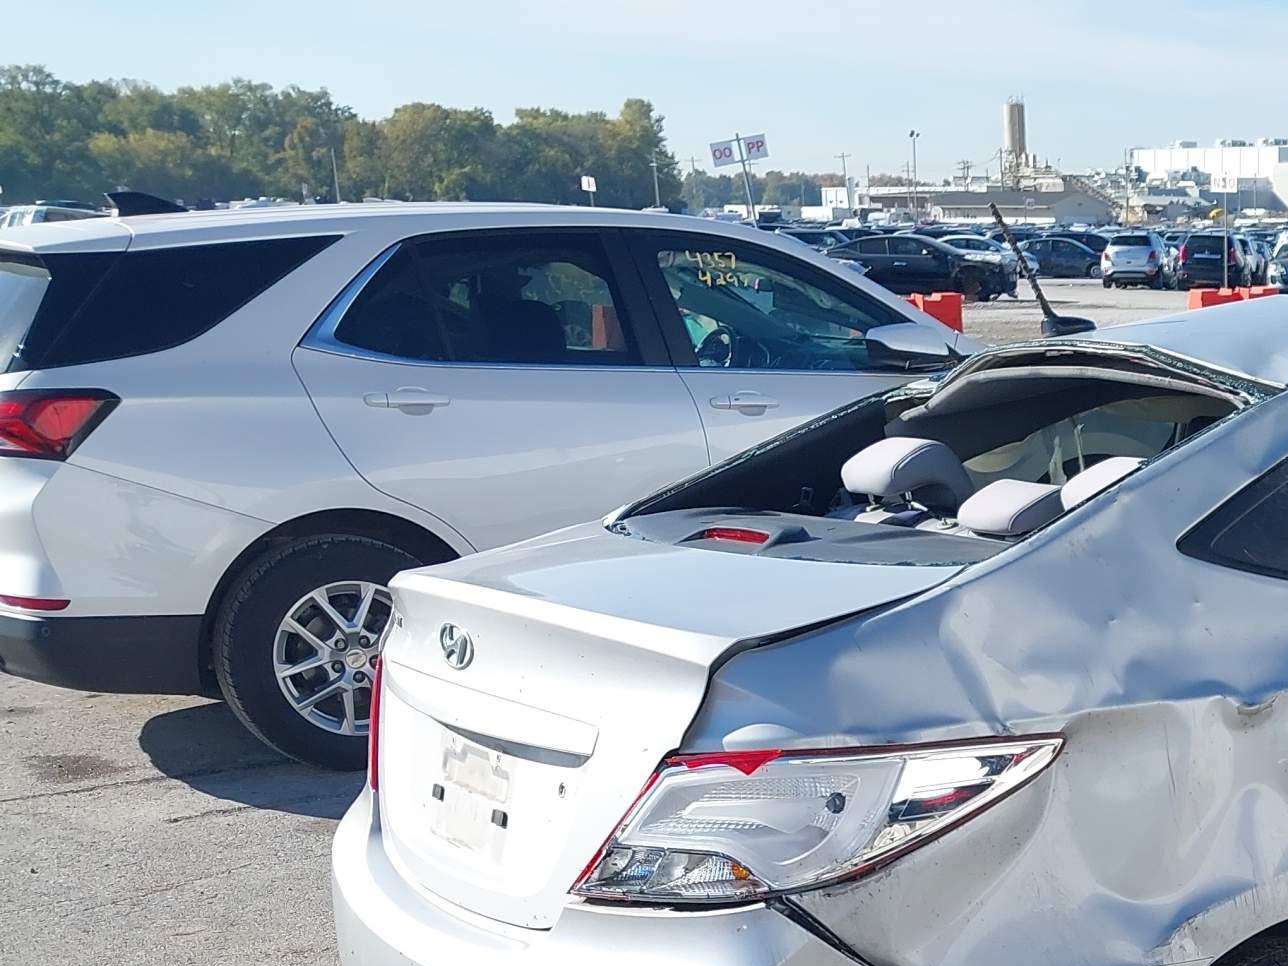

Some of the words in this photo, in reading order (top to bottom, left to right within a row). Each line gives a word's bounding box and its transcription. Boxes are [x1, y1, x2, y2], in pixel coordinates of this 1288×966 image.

[713, 147, 732, 160] OO
[747, 140, 764, 154] PP
[685, 250, 736, 269] 4357
